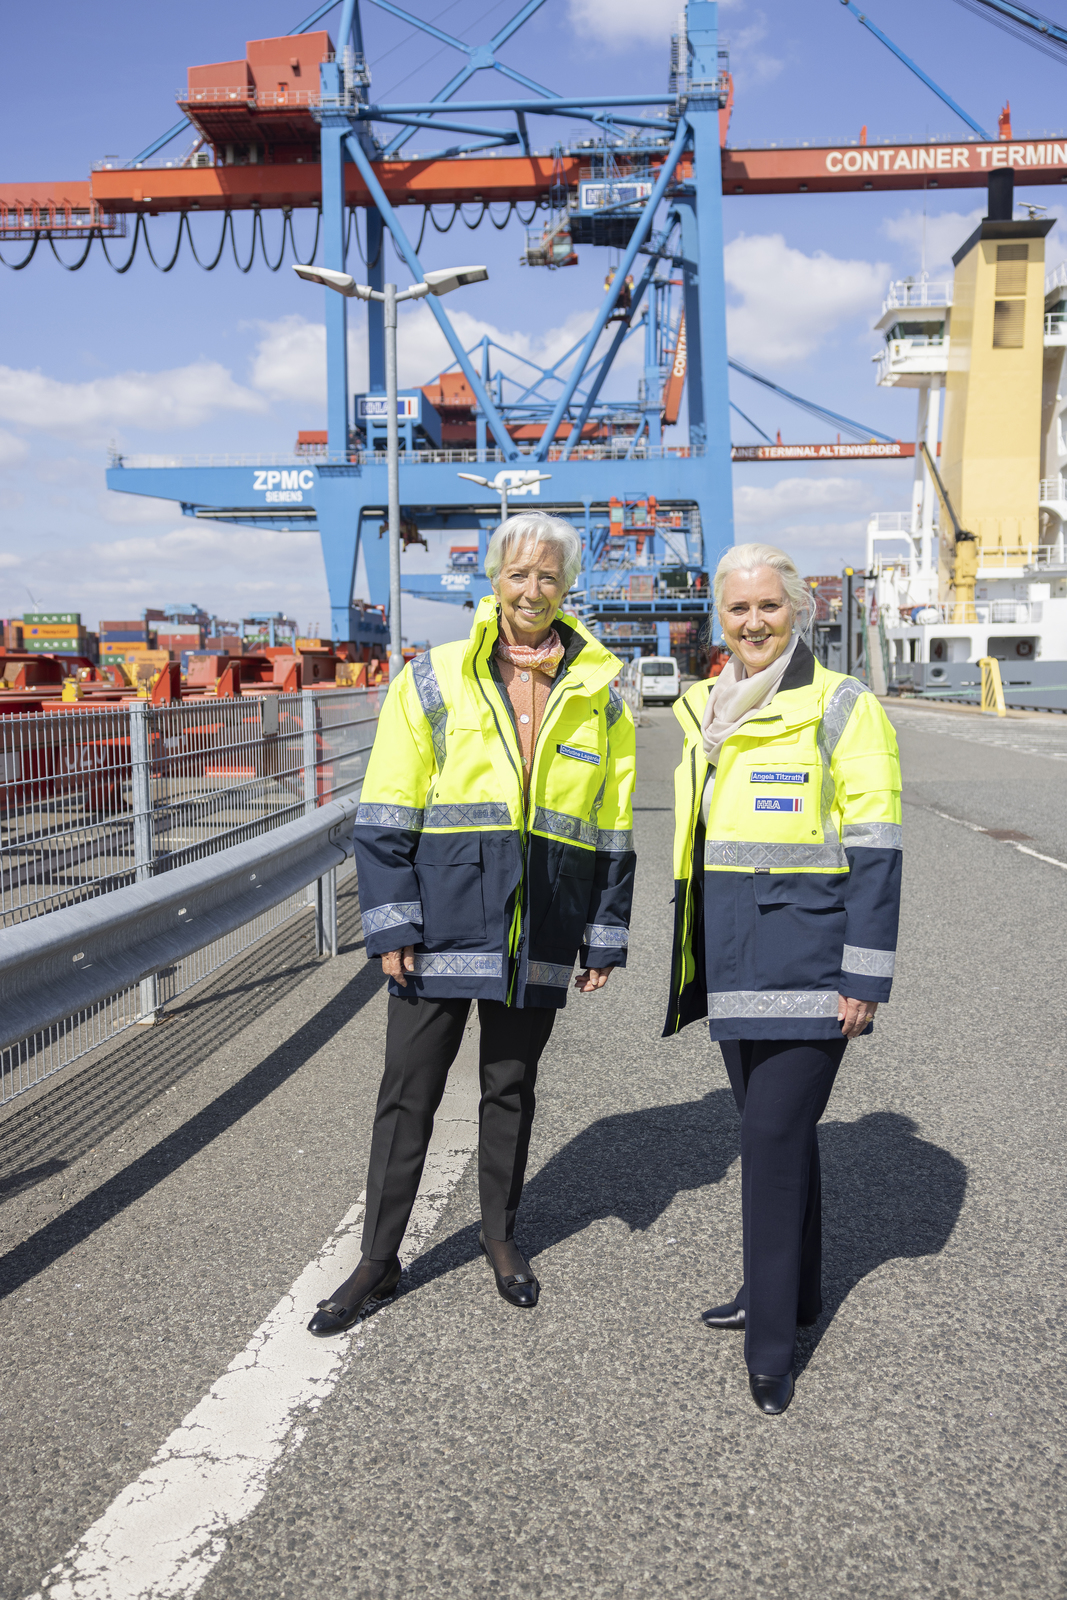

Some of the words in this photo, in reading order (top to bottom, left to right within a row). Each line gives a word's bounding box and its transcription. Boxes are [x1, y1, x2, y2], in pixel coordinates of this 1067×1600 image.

[825, 148, 970, 172] CONTAINER
[765, 446, 817, 457] TERMINAL
[818, 444, 901, 456] ALTENWERDER
[253, 470, 314, 490] ZPMC
[265, 490, 303, 503] SIEMENS
[440, 574, 470, 585] ZPMC
[752, 772, 775, 781] Angela
[756, 799, 781, 810] HHLA
